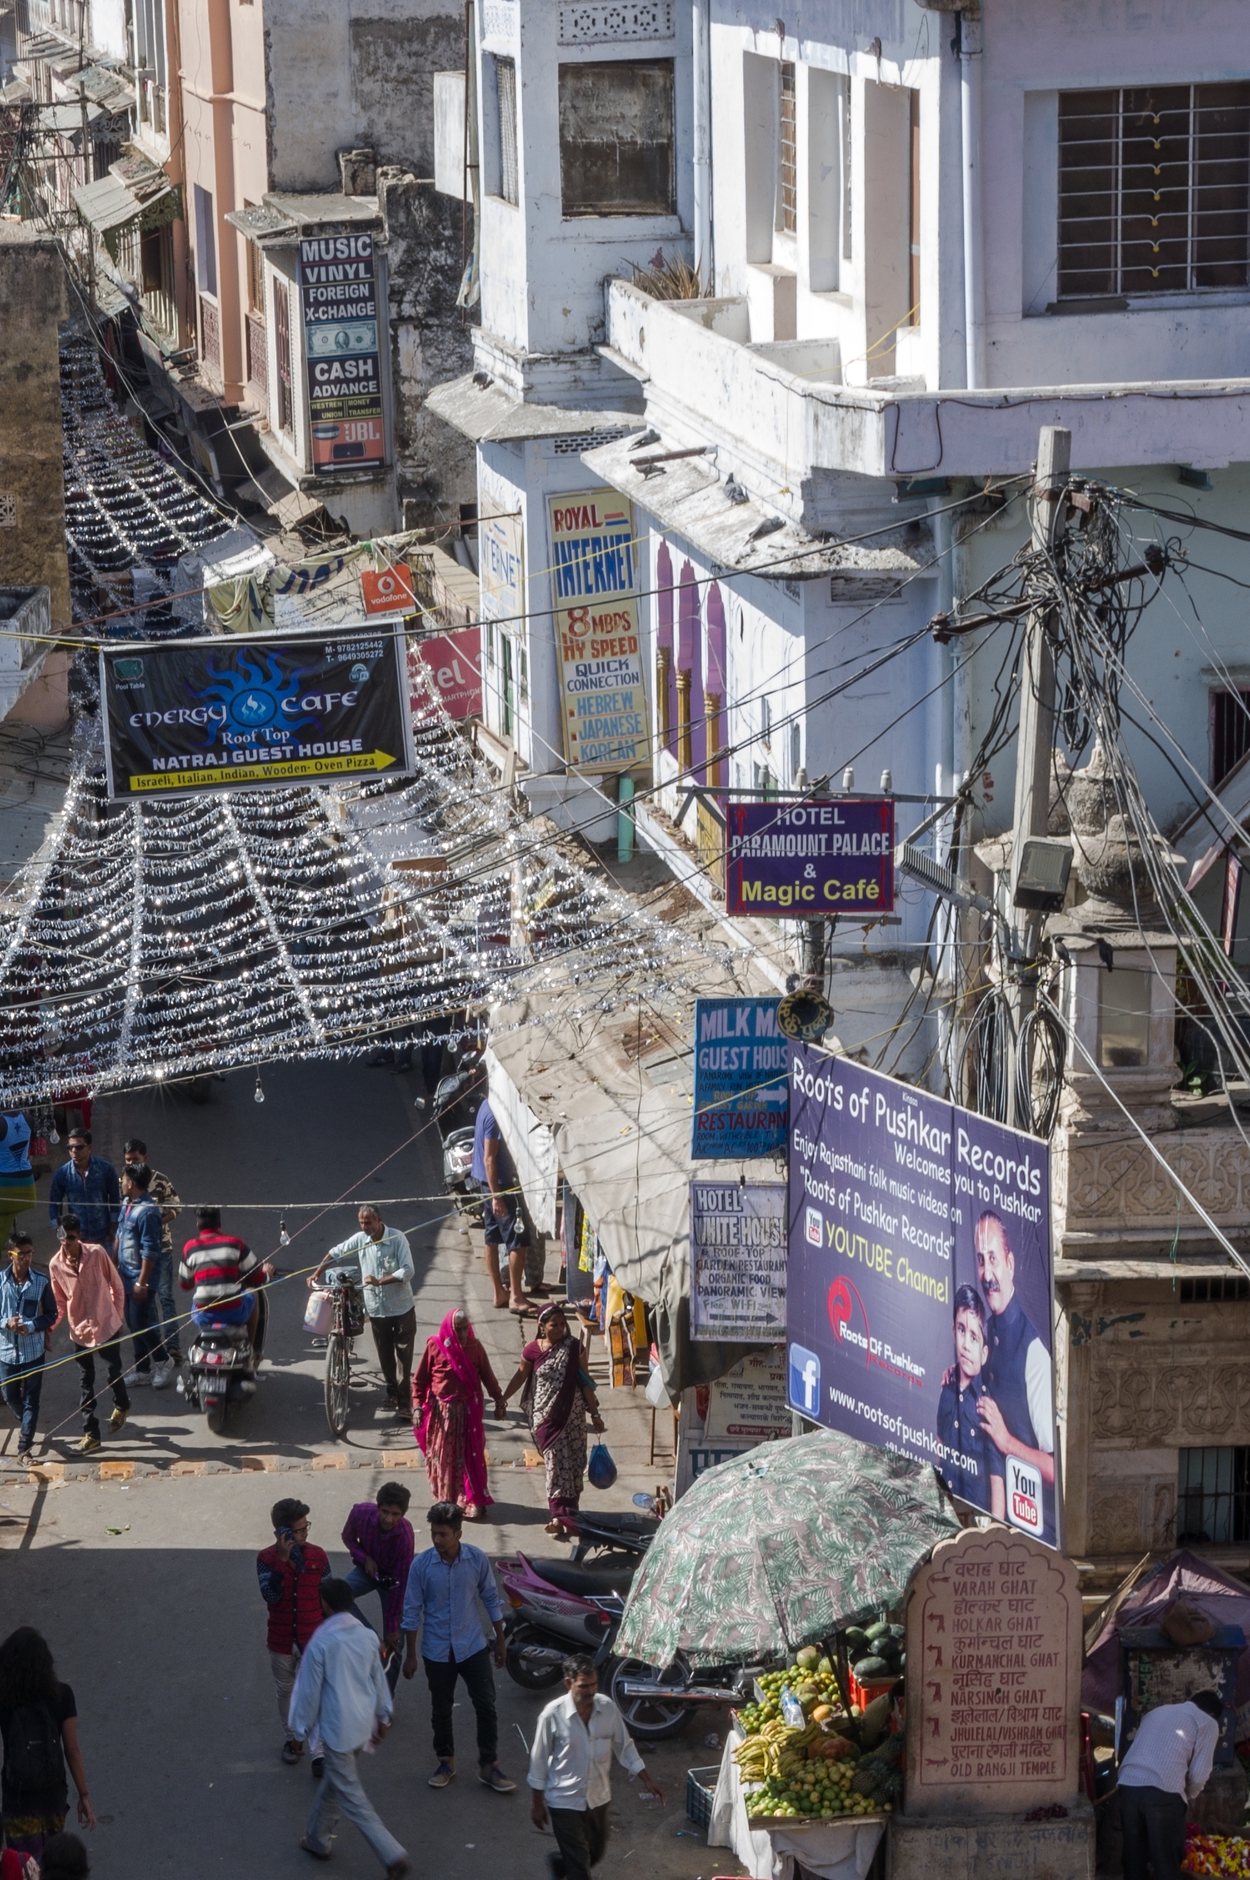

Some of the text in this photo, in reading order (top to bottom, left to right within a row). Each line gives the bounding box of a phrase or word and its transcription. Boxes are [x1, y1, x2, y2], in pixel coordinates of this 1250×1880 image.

[302, 236, 372, 262] MUSIC
[305, 262, 372, 283] VINYL
[309, 283, 370, 302] FOREIGN
[305, 302, 376, 321] X-CHANGE
[314, 358, 374, 381] CASH
[312, 381, 378, 398] ADVANCE
[311, 398, 371, 410] WESTREN MONEY
[321, 407, 381, 419] UNION TRANSFER
[345, 421, 381, 442] JBL
[553, 504, 603, 533] ROYAL
[553, 533, 634, 599] INTERNET
[370, 592, 408, 605] vodafone
[567, 606, 632, 638] 8 MBPS
[336, 640, 384, 652] 9782125442
[337, 650, 384, 662] 9649305272
[591, 635, 638, 659] SPEED
[575, 658, 630, 678] QUICK
[130, 682, 146, 690] Table
[566, 671, 640, 693] CONNECTION
[576, 691, 634, 717] HEBREW
[222, 727, 291, 745] Roof Top
[579, 713, 644, 741] JAPANESE
[152, 738, 363, 771] NATRAJ GUEST HOUSE
[580, 739, 637, 765] KOREAN
[136, 756, 376, 788] Israeli, Italian, Indian, Wooden- Oven Pizza
[776, 807, 846, 826] HOTEL
[731, 833, 890, 858] PARAMOUNT PALACE
[803, 863, 817, 879] &
[741, 879, 880, 907] Magic Café
[700, 1007, 751, 1043] MILK
[699, 1047, 750, 1070] GUEST
[697, 1111, 787, 1132] RESTAURAN
[793, 1056, 1042, 1196] Roots of Pushkar Records
[793, 1128, 962, 1225] Enjoy Rajasthani folk music videos on
[894, 1141, 1042, 1224] Welcomes you to Pushkar
[696, 1189, 744, 1213] HOTEL
[800, 1164, 955, 1260] "Roots of Pushkar Records"
[808, 1212, 821, 1228] You
[693, 1215, 740, 1248] WHITE
[695, 1259, 736, 1272] GARDEN
[825, 1220, 949, 1304] YOUTUBE Channel
[708, 1273, 771, 1285] ORGANIC FOOD
[697, 1285, 787, 1299] PANORAMIC VIEW
[839, 1320, 926, 1377] Roots Of Pushkar
[868, 1352, 923, 1387] Records
[829, 1386, 979, 1477] www.rootsofpushkar.com
[1012, 1465, 1036, 1499] You
[1013, 1495, 1038, 1526] Tube
[953, 1560, 1028, 1578] वराह घाट
[952, 1579, 1038, 1597] VARAH GHAT
[1007, 1598, 1037, 1614] घाट
[952, 1615, 1042, 1633] HOLKAR GHAT
[1016, 1633, 1045, 1651] घाट
[951, 1652, 1060, 1670] KURMANCHAL GHAT
[998, 1671, 1028, 1687] घाट
[950, 1688, 1047, 1706] NARSINGH GHAT
[1042, 1706, 1063, 1722] घाट
[951, 1744, 986, 1762] पुराना
[950, 1760, 1057, 1778] OLD RANGJI TEMPLE
